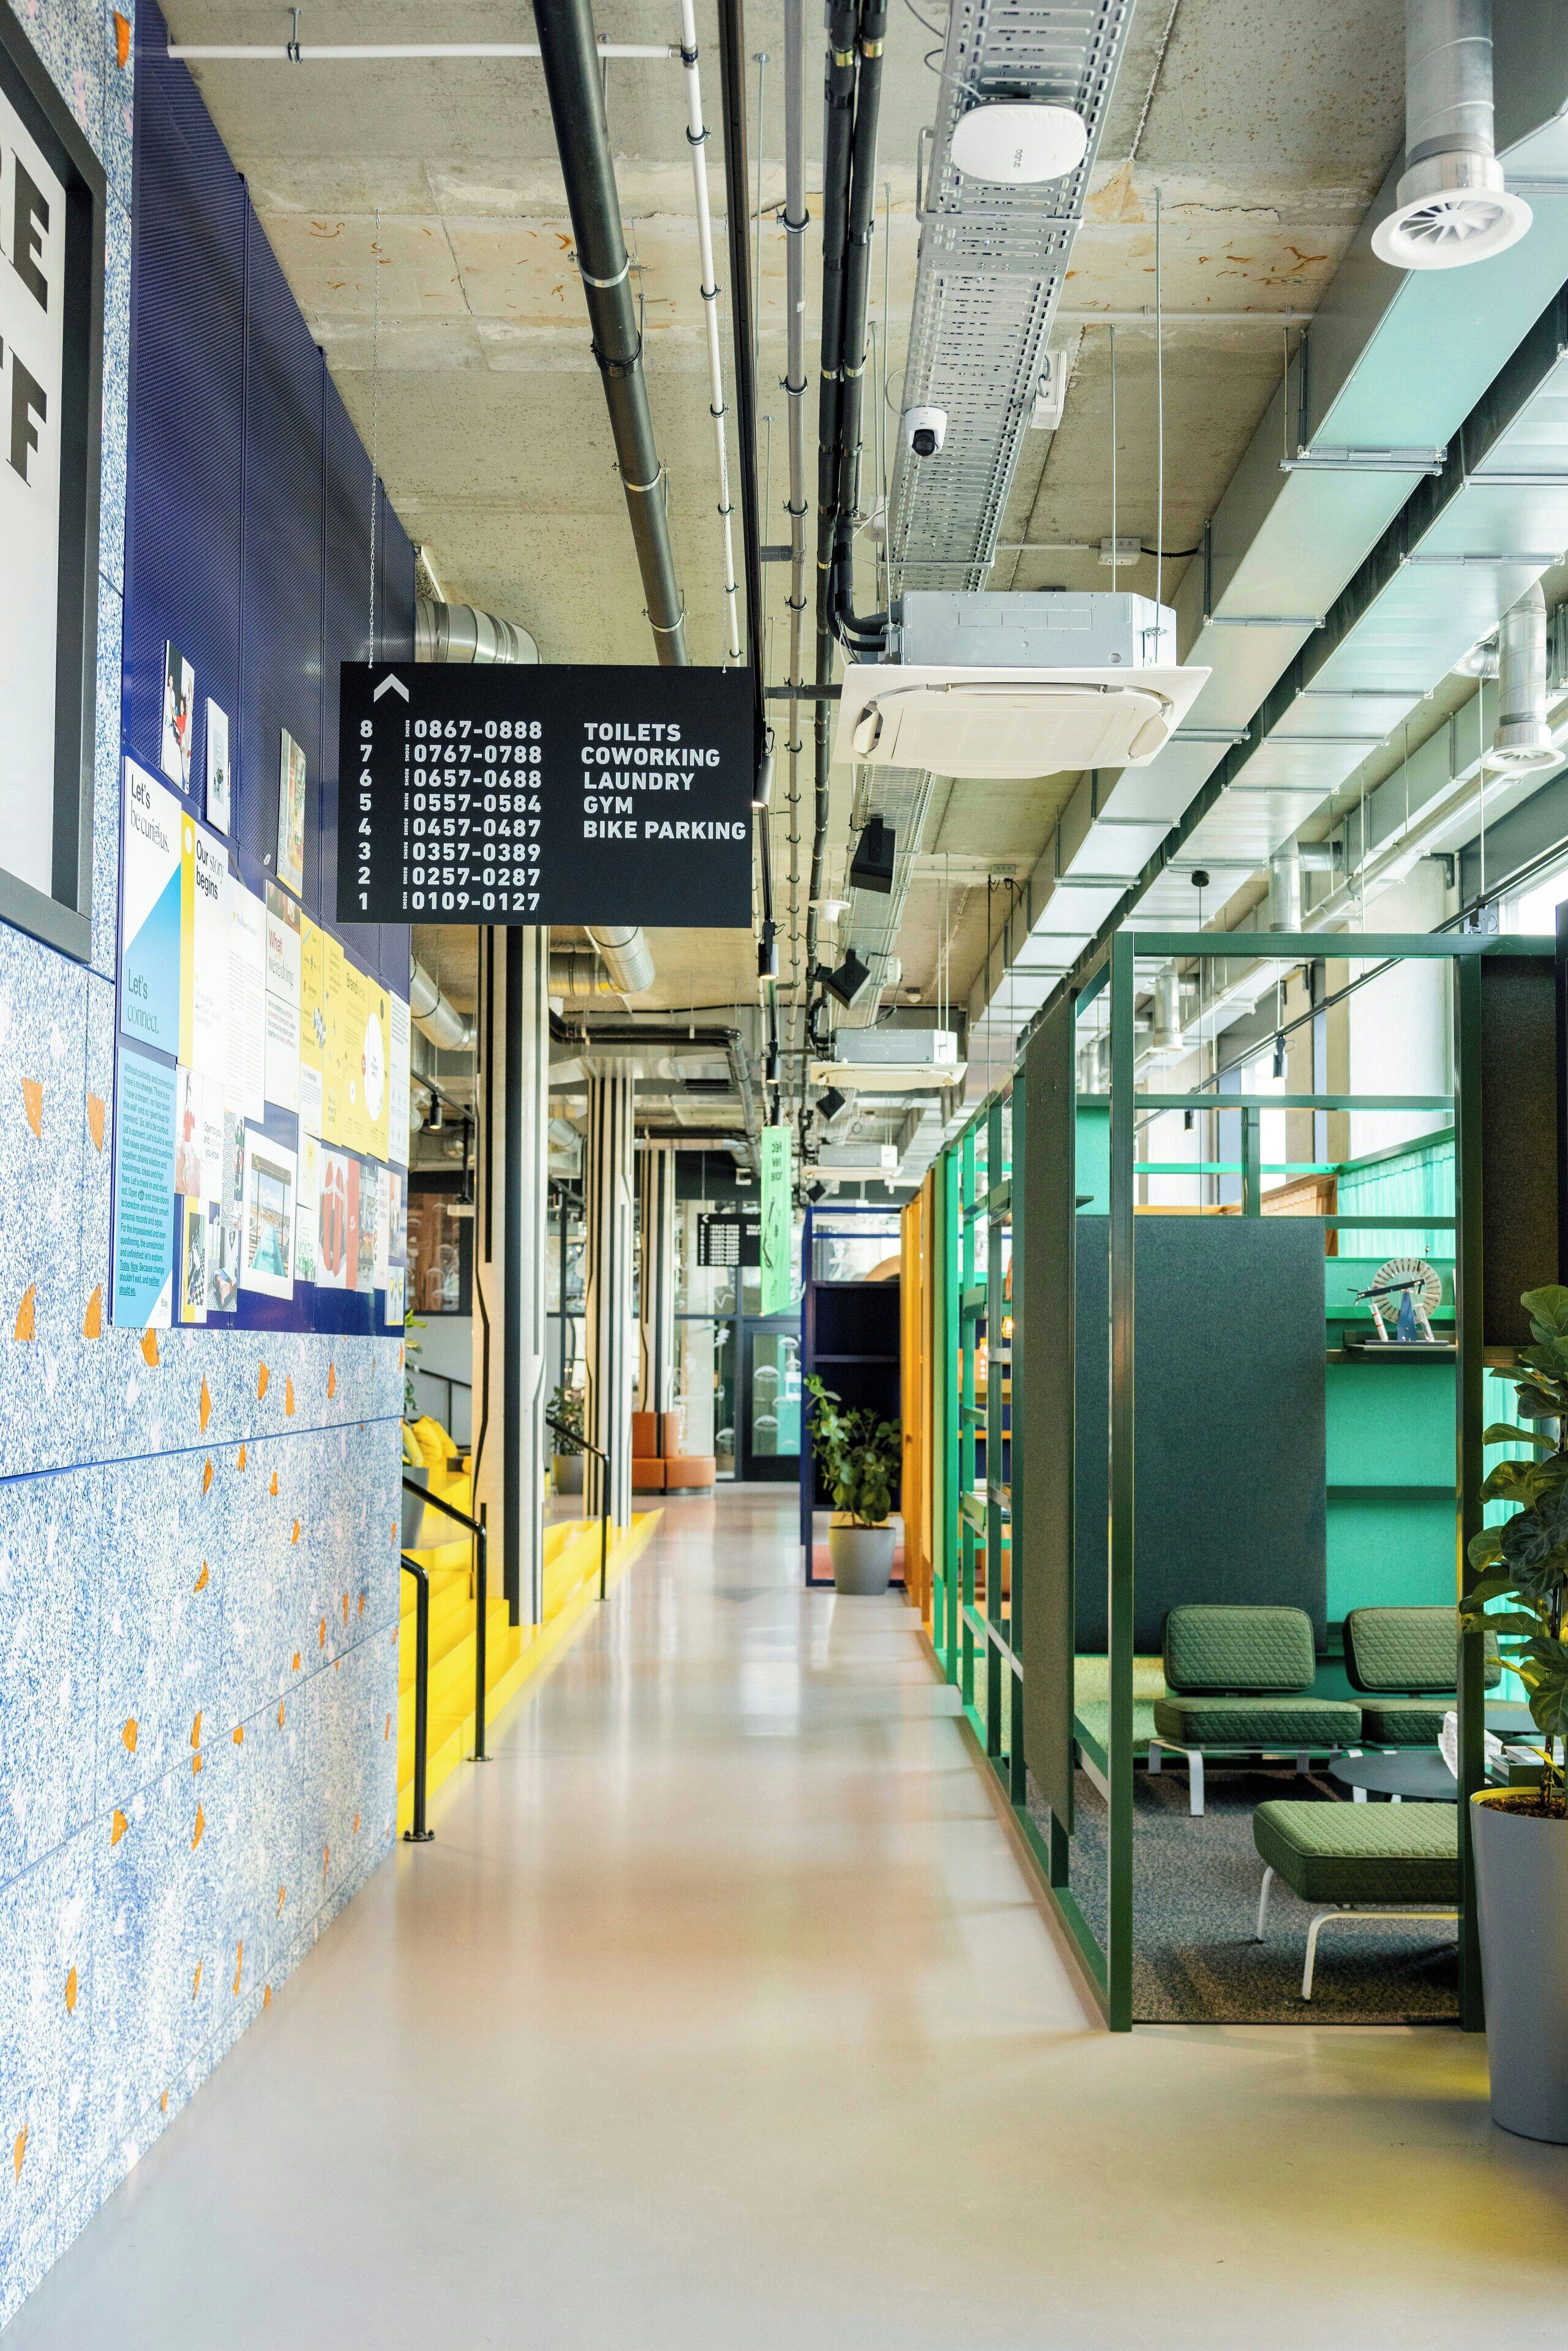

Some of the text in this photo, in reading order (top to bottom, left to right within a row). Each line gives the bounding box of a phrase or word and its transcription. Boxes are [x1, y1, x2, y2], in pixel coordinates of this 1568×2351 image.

[361, 720, 372, 737] 8
[415, 720, 541, 739] 0867-0888
[584, 723, 680, 741] TOILETS
[361, 744, 372, 762] 7
[415, 744, 541, 763] 0767-0788
[582, 747, 719, 767] COWORKING
[360, 769, 372, 786] 6
[415, 769, 541, 788] 0657-0688
[585, 772, 694, 790] LAUNDRY
[132, 774, 150, 809] Let's
[360, 793, 371, 811] 5
[414, 793, 541, 812] 0557-0584
[584, 796, 632, 814] GYM
[131, 800, 140, 831] be
[359, 818, 371, 835] 4
[413, 818, 540, 837] 0457-0487
[584, 821, 746, 839] BIKE PARKING
[359, 842, 370, 860] 3
[413, 842, 540, 861] 0357-0389
[197, 839, 224, 884] Our story
[197, 865, 218, 900] begins
[358, 867, 370, 884] 2
[413, 868, 540, 886] 0257-0287
[359, 893, 367, 910] 1
[412, 892, 539, 910] 0109-0127
[269, 928, 282, 954] What
[129, 969, 148, 1000] Let's
[280, 960, 293, 991] doing
[127, 1005, 159, 1034] connect.
[124, 1062, 137, 1076] Without
[137, 1068, 151, 1083] curiosity
[124, 1074, 135, 1087] there's
[154, 1086, 164, 1098] There's
[122, 1124, 131, 1134] Let's
[157, 1123, 168, 1135] curious.
[130, 1139, 139, 1149] raises
[140, 1141, 151, 1154] glasses
[159, 1147, 173, 1161] questions
[137, 1153, 148, 1164] shares
[149, 1156, 160, 1168] wisdom
[141, 1166, 150, 1176] ideas
[139, 1178, 149, 1188] check
[129, 1187, 137, 1199] Open
[160, 1195, 168, 1205] doors
[121, 1210, 135, 1223] personal
[135, 1214, 147, 1224] records
[125, 1199, 140, 1210] boredom
[159, 1206, 168, 1217] smash
[132, 1224, 152, 1239] impassioned
[146, 1239, 164, 1251] unrestricted
[119, 1259, 130, 1270] Today.
[139, 1262, 152, 1273] Because
[153, 1264, 164, 1276] change
[151, 1253, 163, 1264] explore.
[119, 1271, 134, 1283] shouldn't
[149, 1275, 159, 1286] neither
[119, 1284, 130, 1295] should
